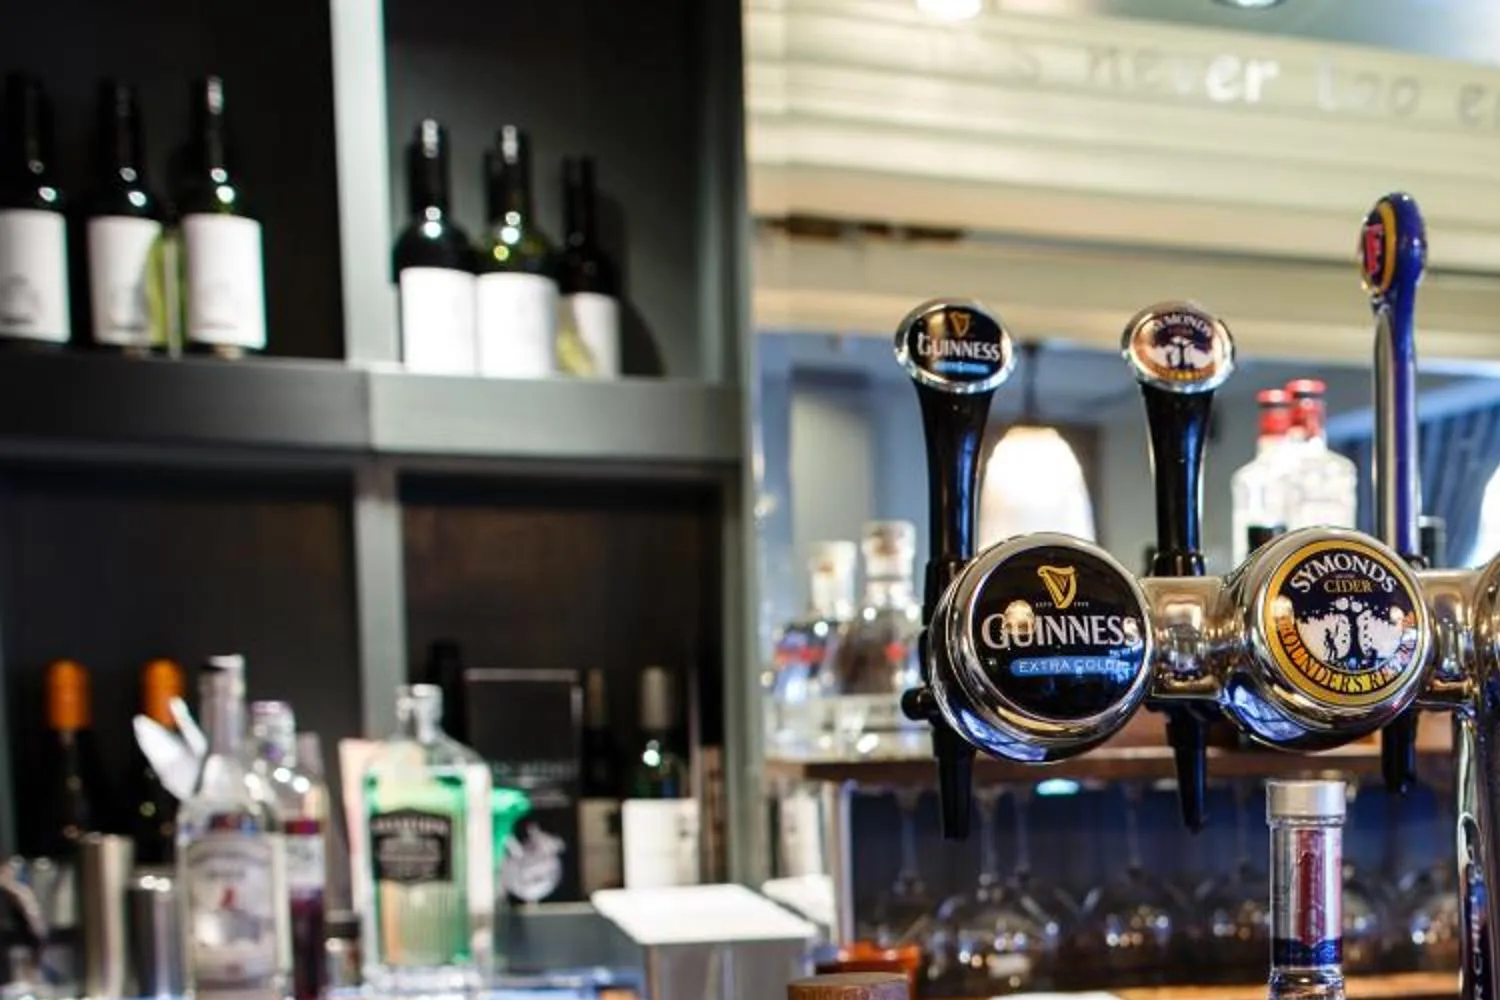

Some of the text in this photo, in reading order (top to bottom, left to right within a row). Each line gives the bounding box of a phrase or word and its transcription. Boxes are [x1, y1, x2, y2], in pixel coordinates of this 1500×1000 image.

[1086, 46, 1280, 102] never
[918, 333, 1001, 362] GUINNESS
[1290, 553, 1398, 594] SYMONDS
[1323, 578, 1373, 594] CIDER
[981, 613, 1142, 650] GUINNESS
[1019, 658, 1070, 674] EXTRA
